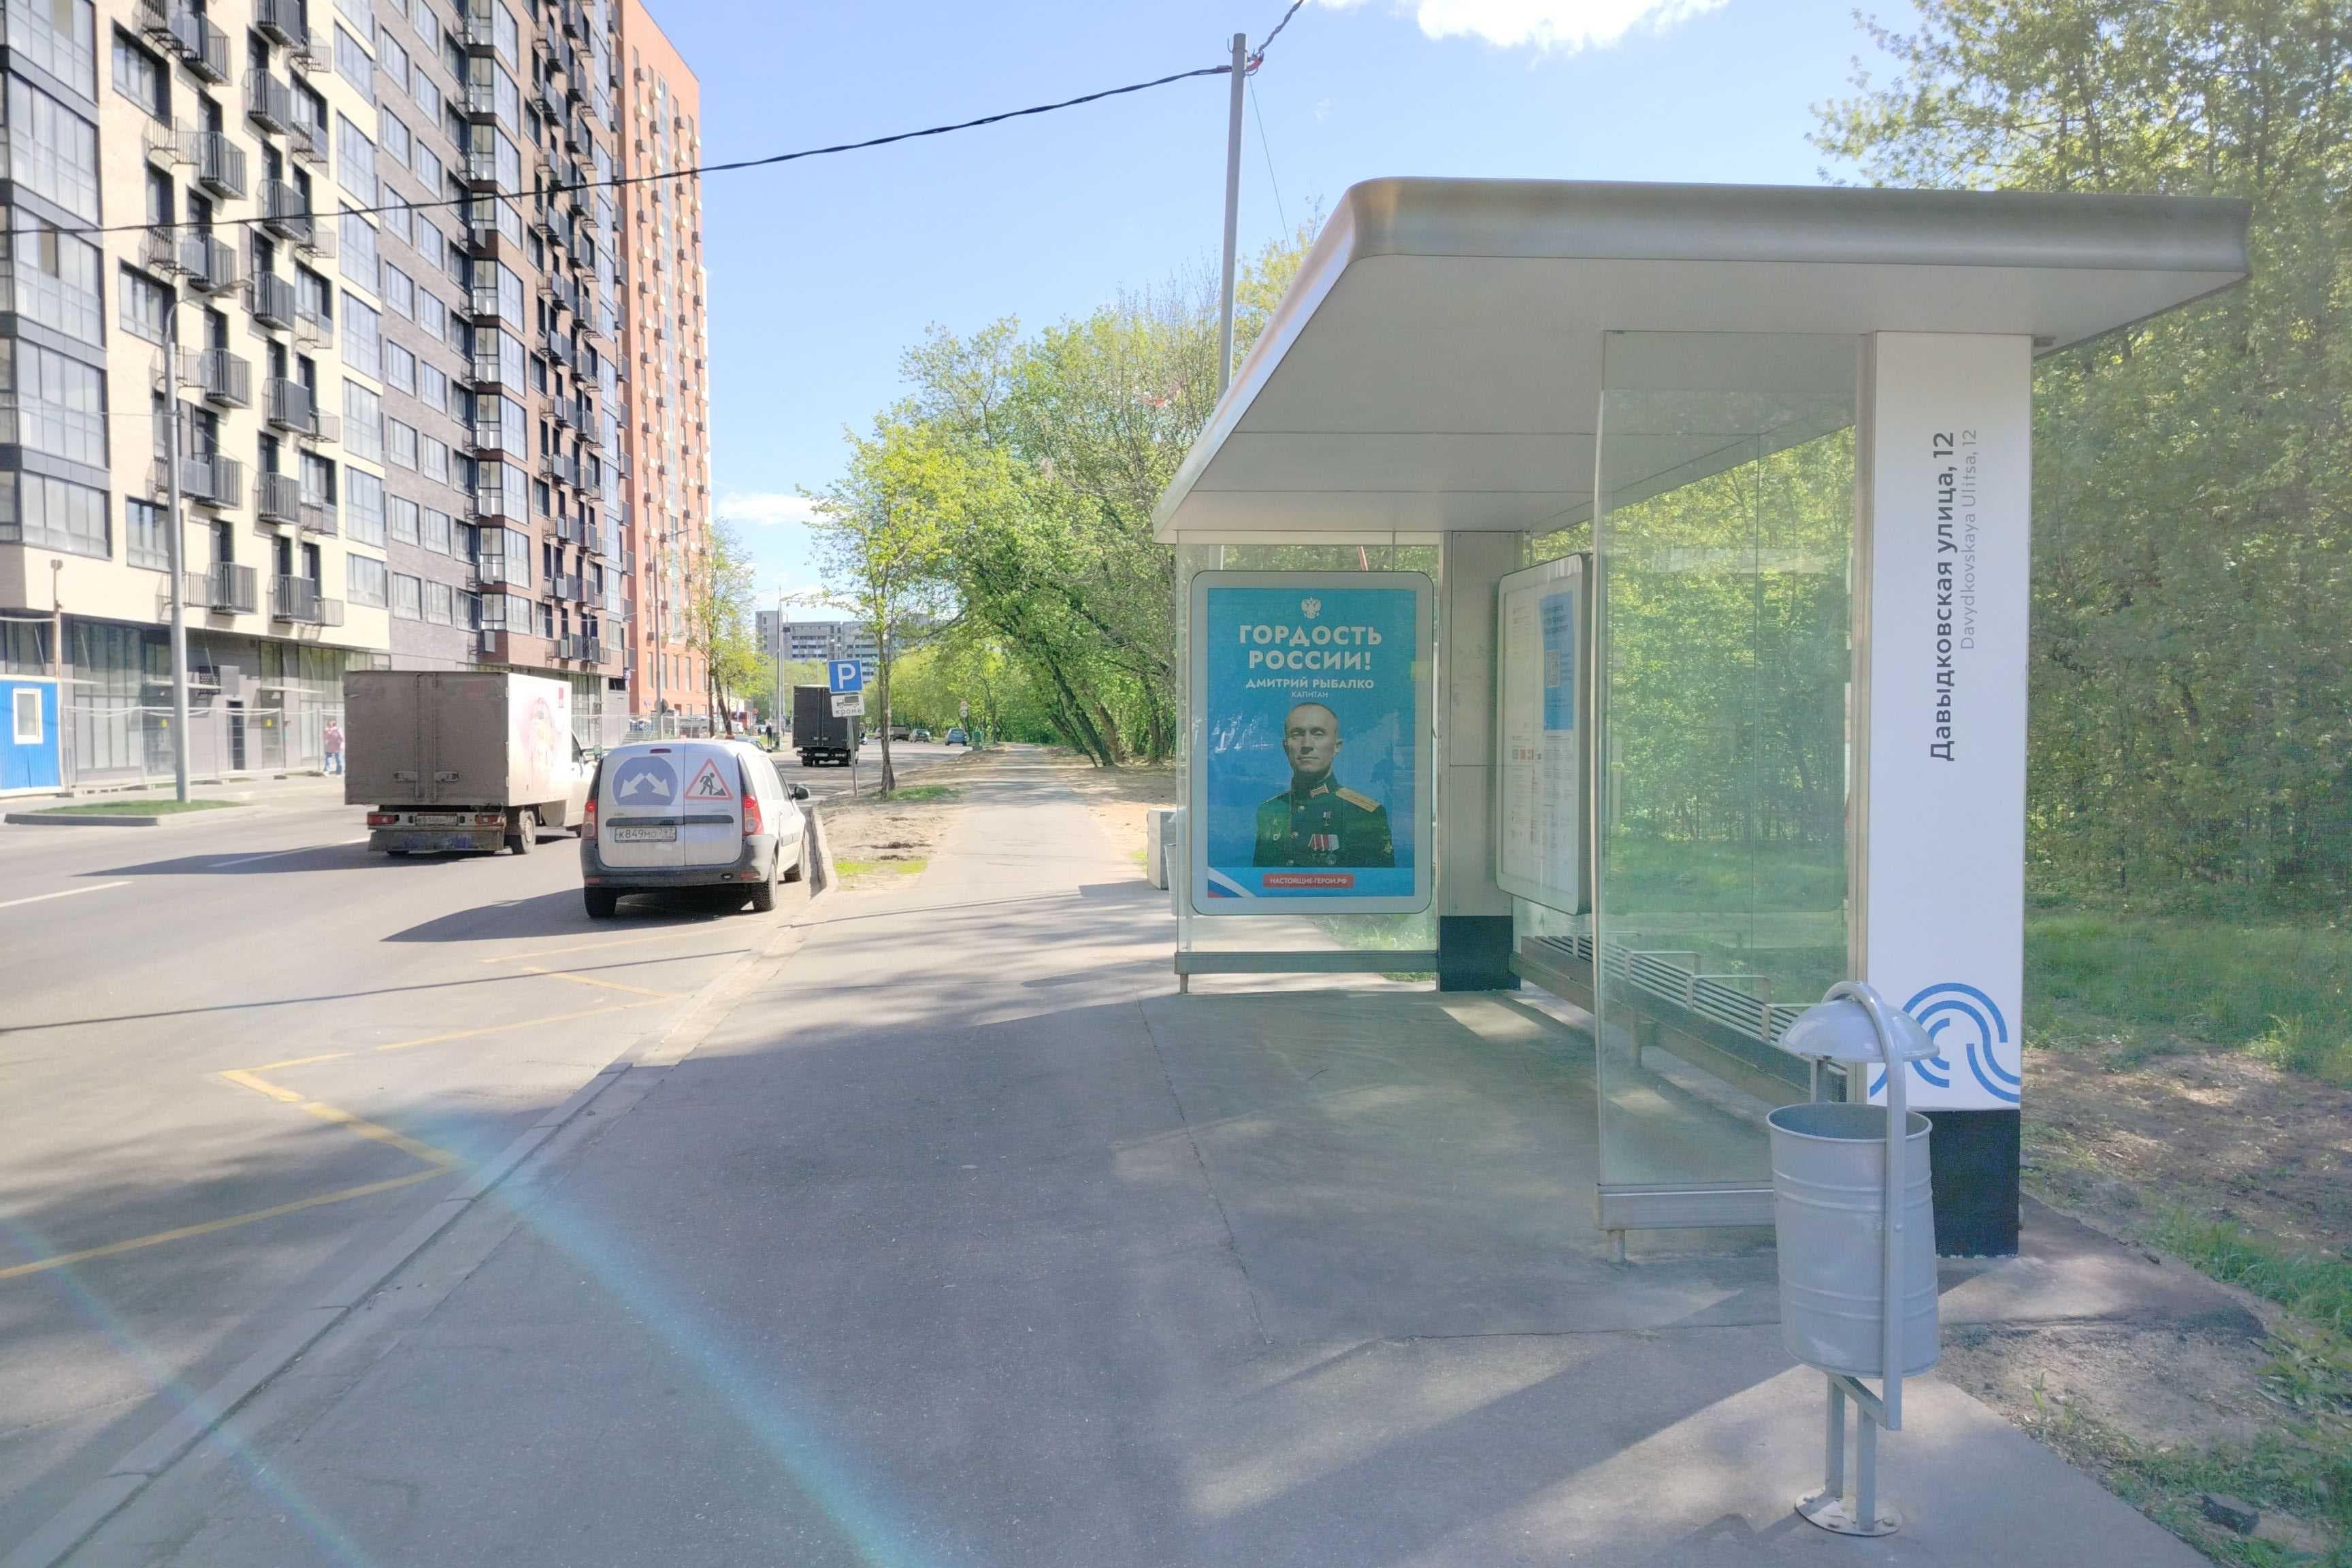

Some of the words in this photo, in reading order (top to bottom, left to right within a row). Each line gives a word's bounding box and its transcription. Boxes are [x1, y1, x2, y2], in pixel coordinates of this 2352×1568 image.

[1933, 432, 1955, 458] 12
[1961, 429, 1976, 447] 12
[1961, 451, 1979, 507] Ulitsa,
[1938, 466, 1957, 554] улица,
[1960, 513, 1979, 650] Davydkovskaya
[1239, 625, 1382, 647] ГОРДОСТЬ
[1249, 651, 1371, 670] РОССИИ!
[1930, 561, 1955, 762] Давыдковская
[1245, 676, 1308, 689] ДМИТРИЙ
[1312, 679, 1375, 689] РЫБАЛКО
